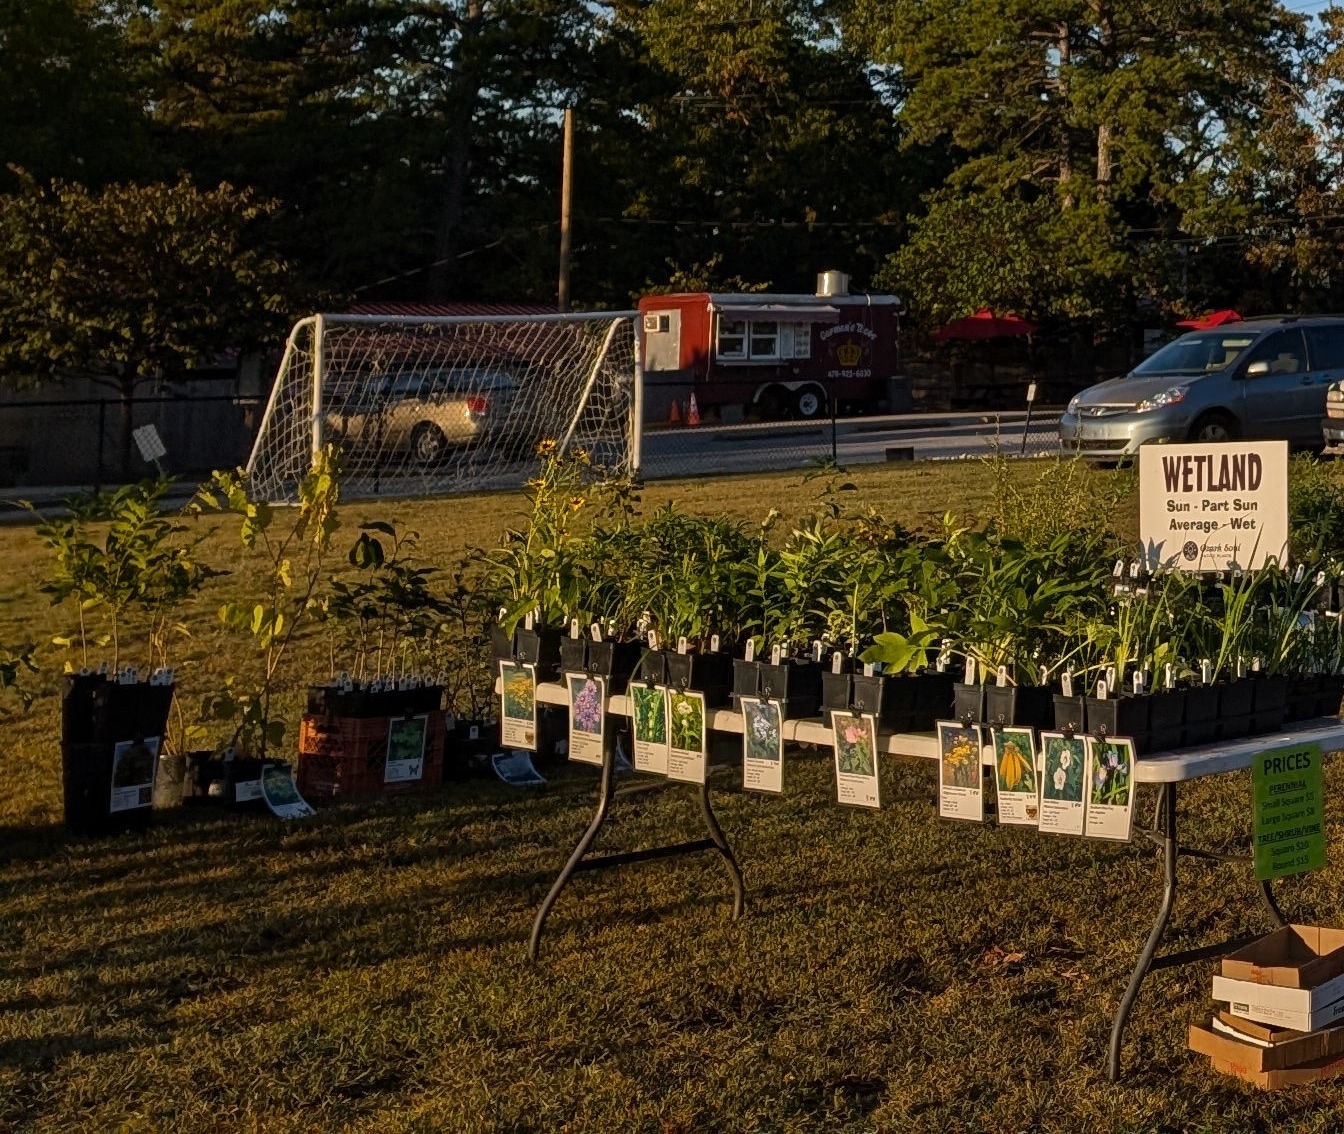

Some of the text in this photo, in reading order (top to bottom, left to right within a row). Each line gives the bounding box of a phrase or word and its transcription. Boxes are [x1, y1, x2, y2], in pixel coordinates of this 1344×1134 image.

[1162, 452, 1263, 493] WETLAND
[1166, 499, 1190, 513] Sun
[1202, 499, 1230, 512] Part
[1233, 498, 1258, 511] Sun
[1169, 518, 1219, 534] Average
[1230, 517, 1257, 530] Wet
[1263, 752, 1311, 776] PRICES
[1281, 795, 1304, 807] Square
[1261, 813, 1280, 826] Large
[1281, 810, 1305, 822] Square
